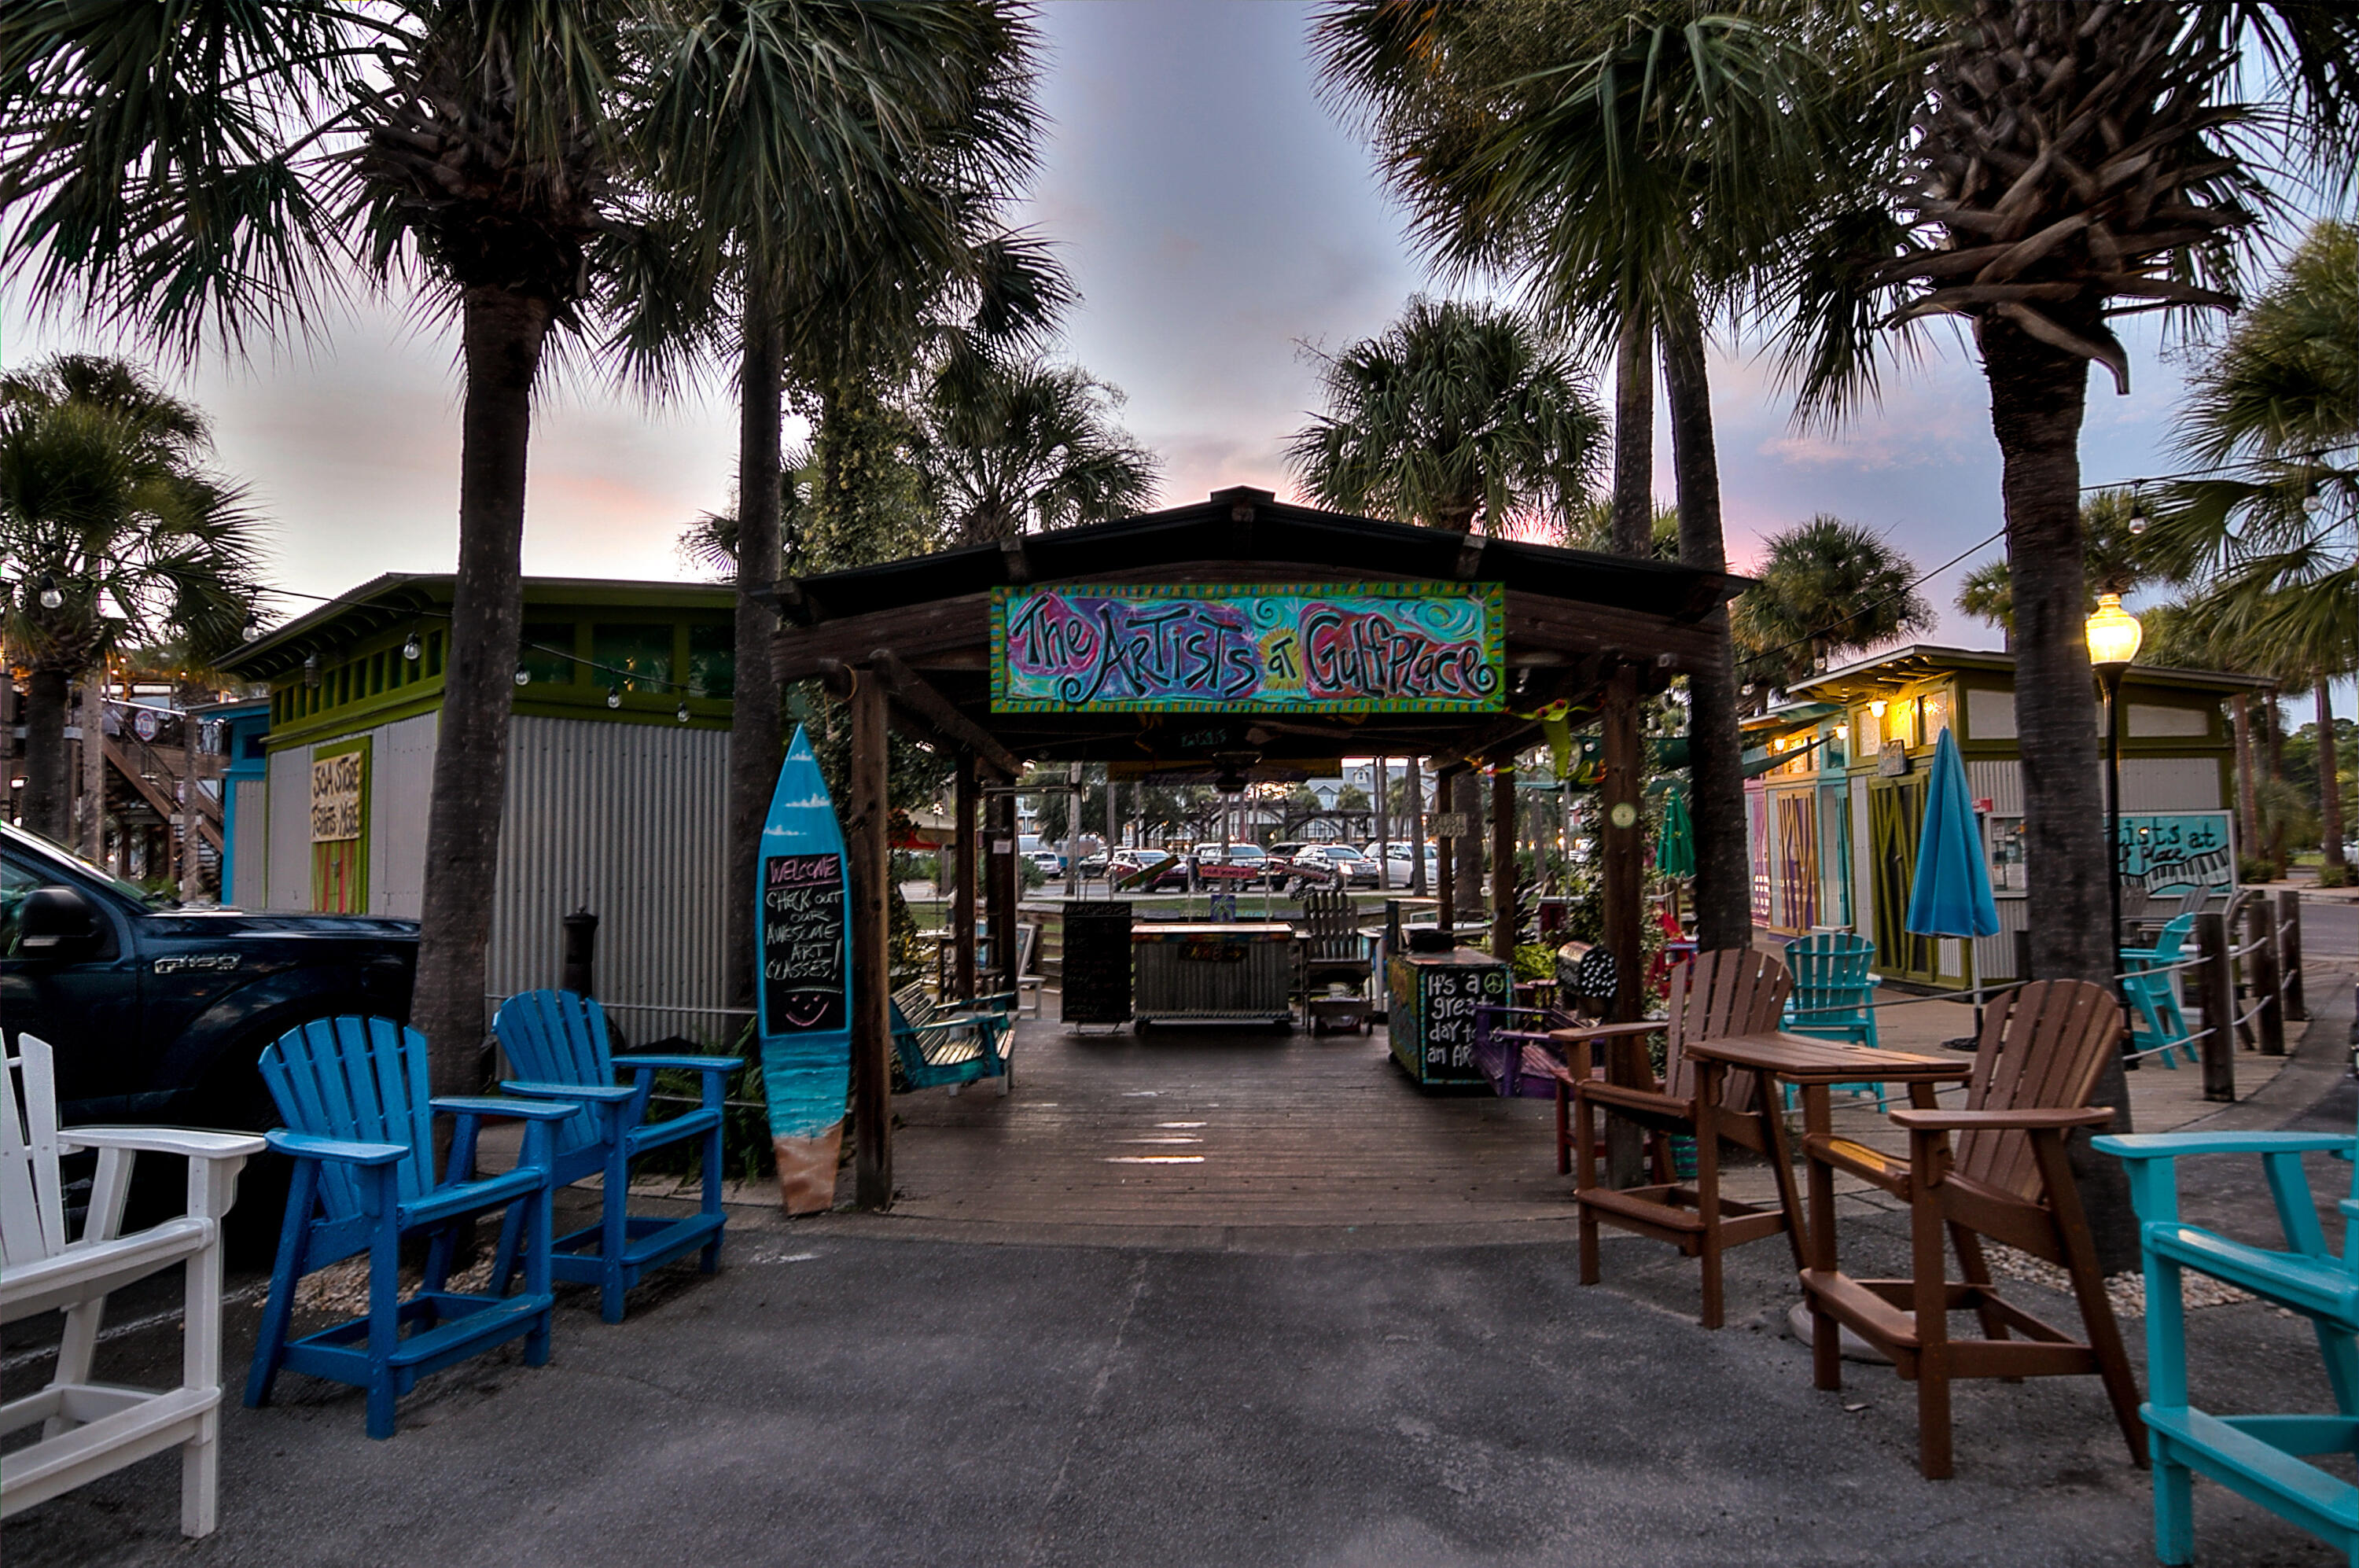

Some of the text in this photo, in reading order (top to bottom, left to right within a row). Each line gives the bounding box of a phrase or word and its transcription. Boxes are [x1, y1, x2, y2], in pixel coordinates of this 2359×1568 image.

[1012, 595, 1093, 668] The
[2188, 823, 2216, 849] at
[770, 856, 840, 884] WELCOME
[767, 921, 841, 946] AWESOME
[791, 942, 833, 962] ART
[1428, 973, 1481, 996] It's a
[1427, 1047, 1447, 1065] an
